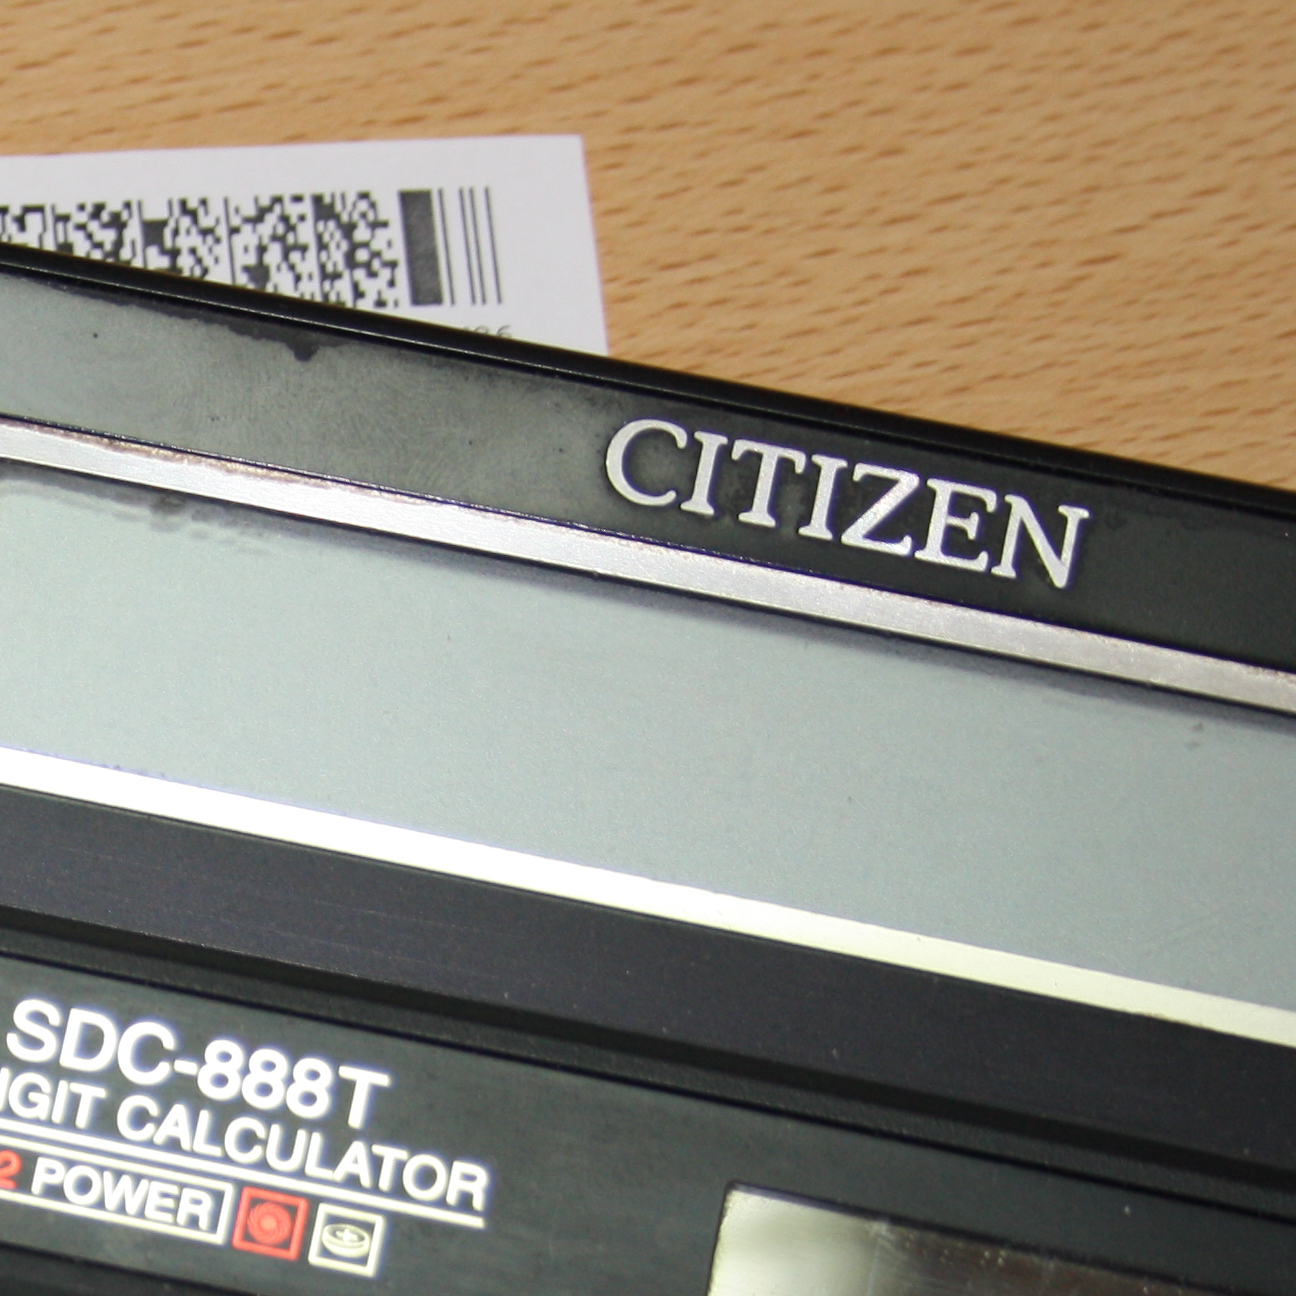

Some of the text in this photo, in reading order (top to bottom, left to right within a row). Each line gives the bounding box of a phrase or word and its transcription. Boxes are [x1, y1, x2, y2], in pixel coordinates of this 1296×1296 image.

[606, 419, 1090, 589] CITIZEN
[6, 998, 390, 1130] SDC-888T
[30, 1155, 213, 1231] POWER
[116, 1094, 490, 1212] CALCULATOR
